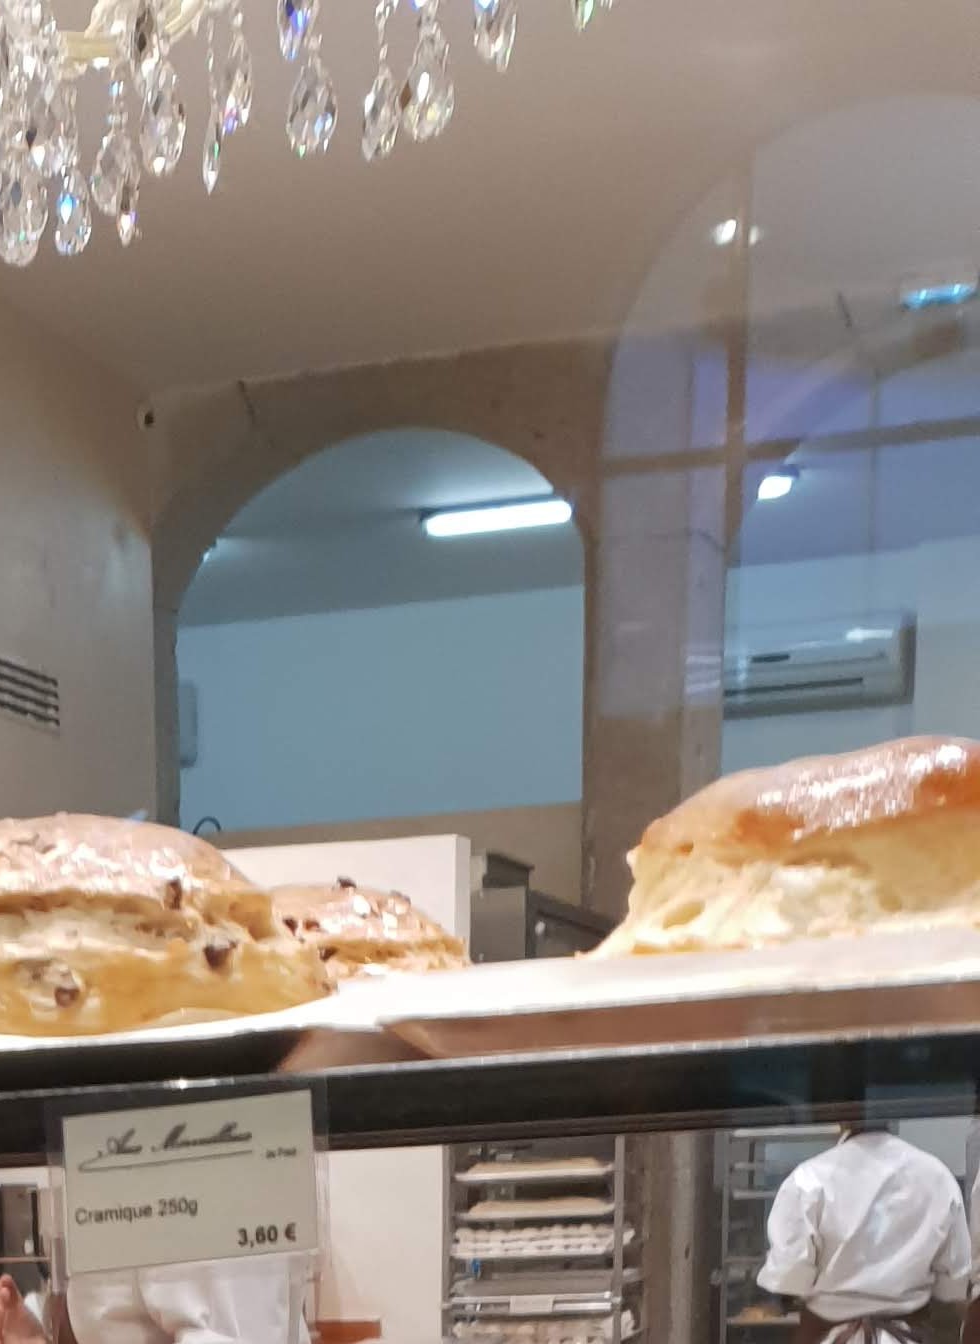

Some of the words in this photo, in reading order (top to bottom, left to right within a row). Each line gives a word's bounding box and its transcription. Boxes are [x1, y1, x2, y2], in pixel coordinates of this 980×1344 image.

[75, 1205, 153, 1225] Cramique
[157, 1197, 198, 1218] 250g
[237, 1224, 278, 1249] 3,60
[284, 1222, 297, 1242] €
